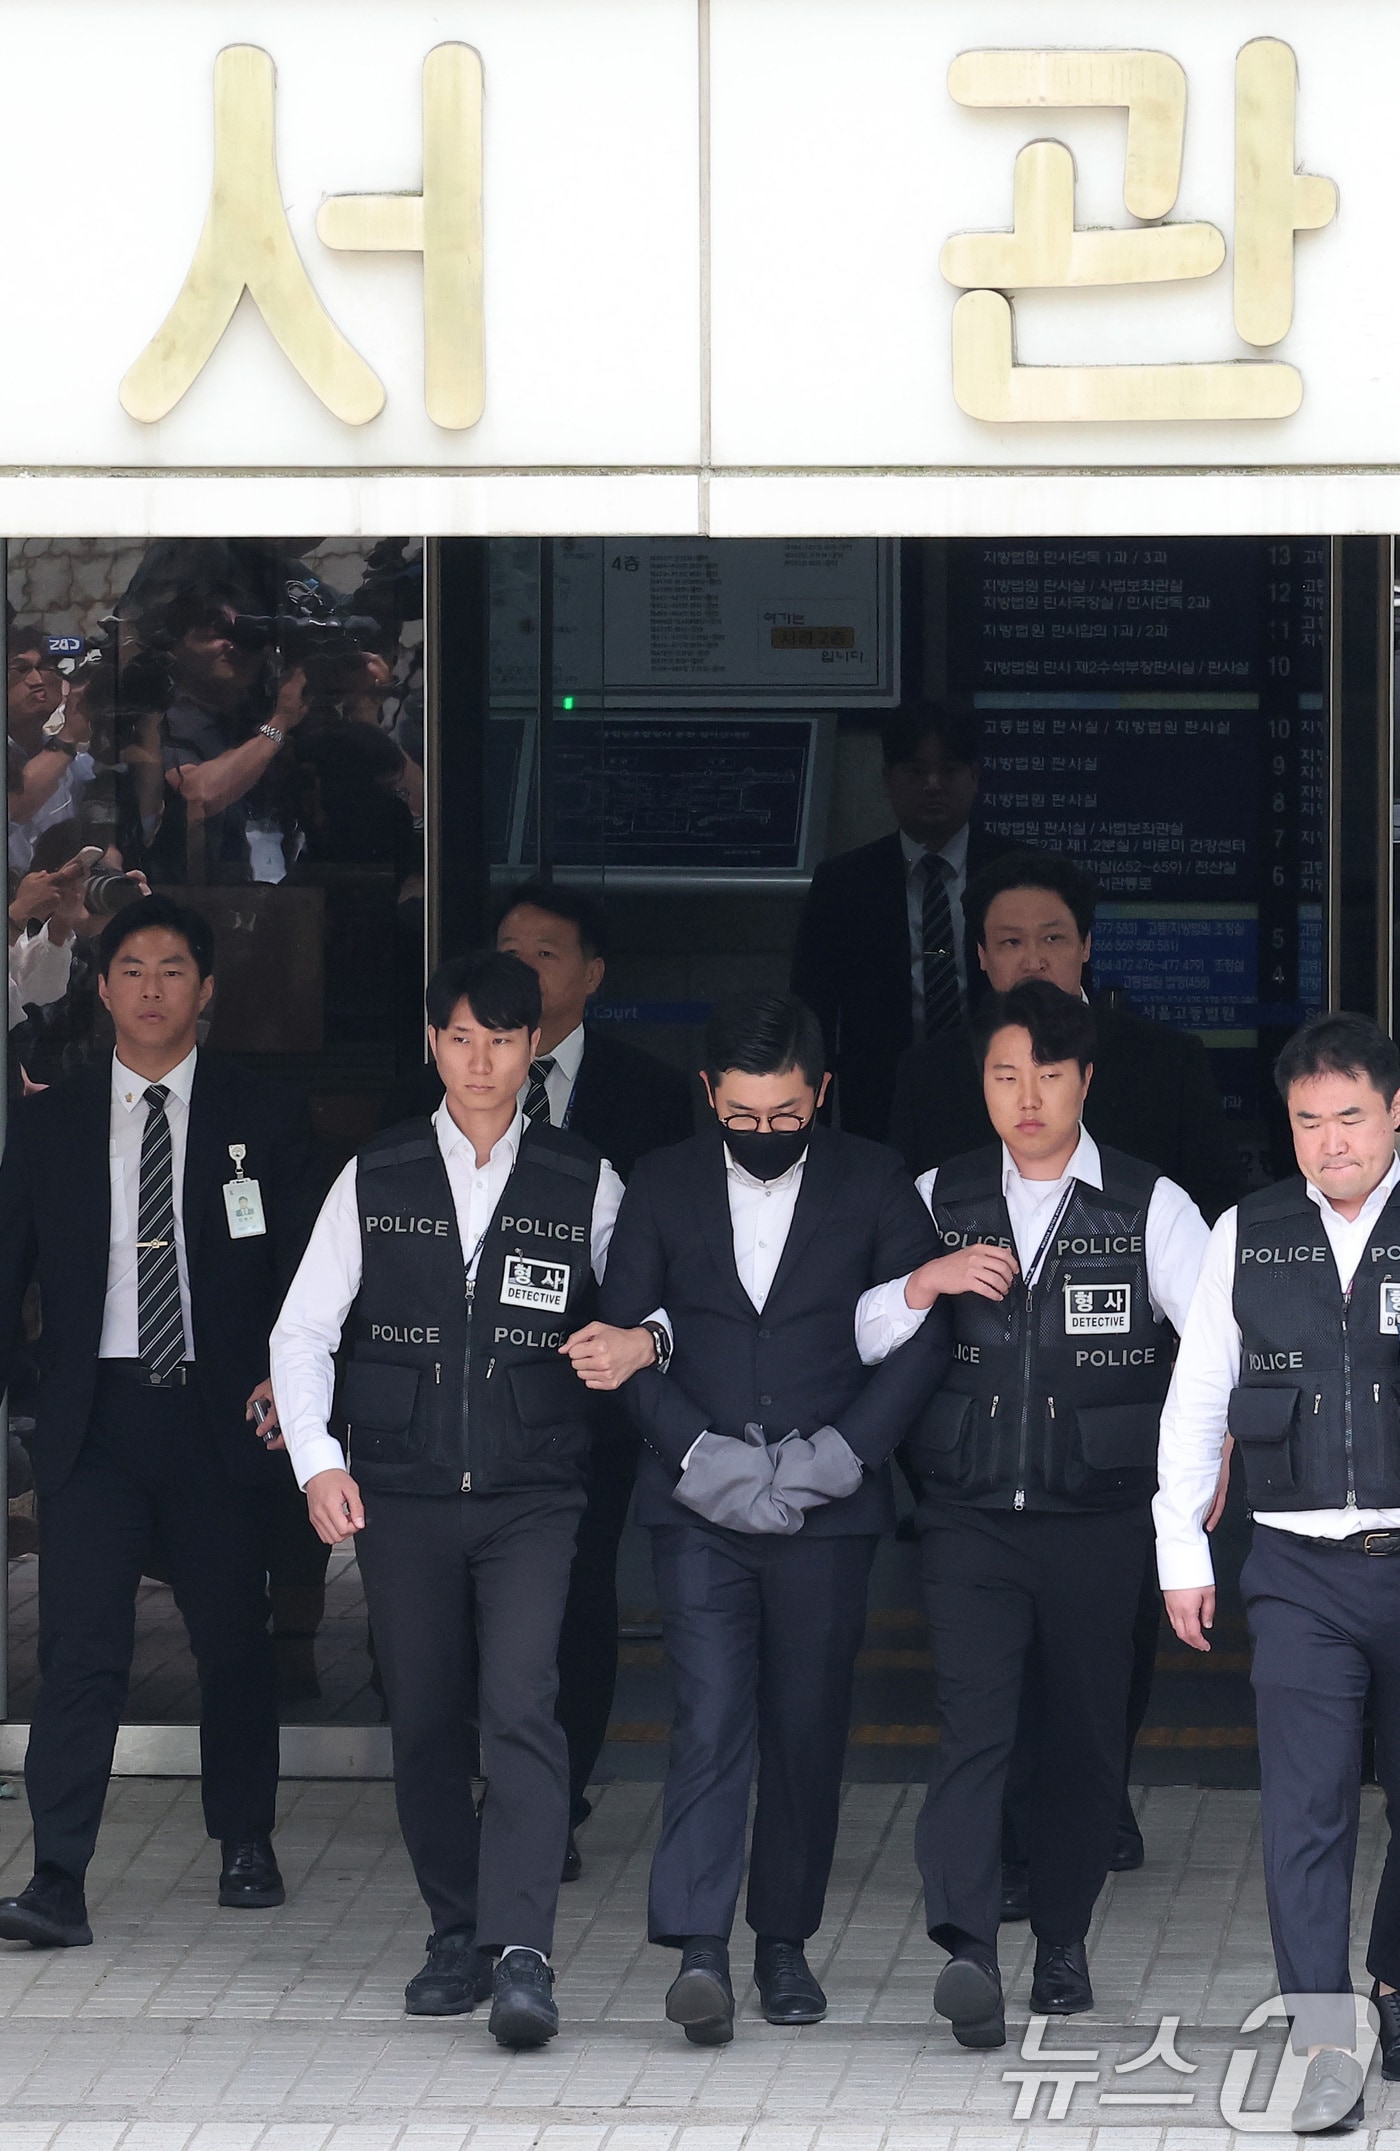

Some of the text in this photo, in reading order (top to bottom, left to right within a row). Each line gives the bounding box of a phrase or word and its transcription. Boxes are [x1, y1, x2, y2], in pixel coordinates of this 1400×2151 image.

[611, 555, 640, 572] 4층
[983, 550, 1039, 565] 지방법원
[1268, 545, 1291, 566] 13
[982, 578, 1039, 593] 지방법원
[1268, 582, 1291, 603] 12
[982, 595, 1038, 610] 지방법원
[1187, 595, 1210, 610] 2과
[763, 612, 805, 625] 여기는
[982, 623, 1045, 638] 지방법원
[1145, 623, 1169, 638] 2과
[1269, 620, 1289, 640] 11
[821, 651, 864, 663] 입니다
[983, 660, 1039, 675] 지방법원
[1268, 656, 1291, 677] 10
[983, 719, 1046, 734] 고등법원
[1052, 719, 1099, 734] 판사실
[1115, 719, 1178, 734] 지방법원
[1184, 719, 1231, 734] 판사실
[1269, 718, 1291, 739] 10
[983, 757, 1098, 771] 지방법원 판사실
[1273, 755, 1286, 776] 9
[983, 793, 1098, 808] 지방법원 판사실
[1272, 792, 1285, 813] 8
[983, 821, 1040, 836] 지방법원
[1043, 821, 1085, 836] 판사실
[1274, 829, 1285, 848] 7
[1194, 860, 1237, 875] 전산실
[1272, 865, 1285, 886] 6
[1272, 928, 1284, 948] 5
[1272, 966, 1285, 984] 4
[593, 1004, 639, 1020] Court
[1143, 1005, 1235, 1022] 서울고등법원
[366, 1216, 449, 1236] POLICE
[500, 1215, 586, 1242] POLICE
[1057, 1236, 1142, 1256] POLICE
[1241, 1246, 1326, 1264] POLICE
[508, 1287, 561, 1305] DETECTIVE
[1072, 1315, 1125, 1328] DETECTIVE
[372, 1324, 440, 1344] POLICE
[1075, 1348, 1155, 1366] POLICE
